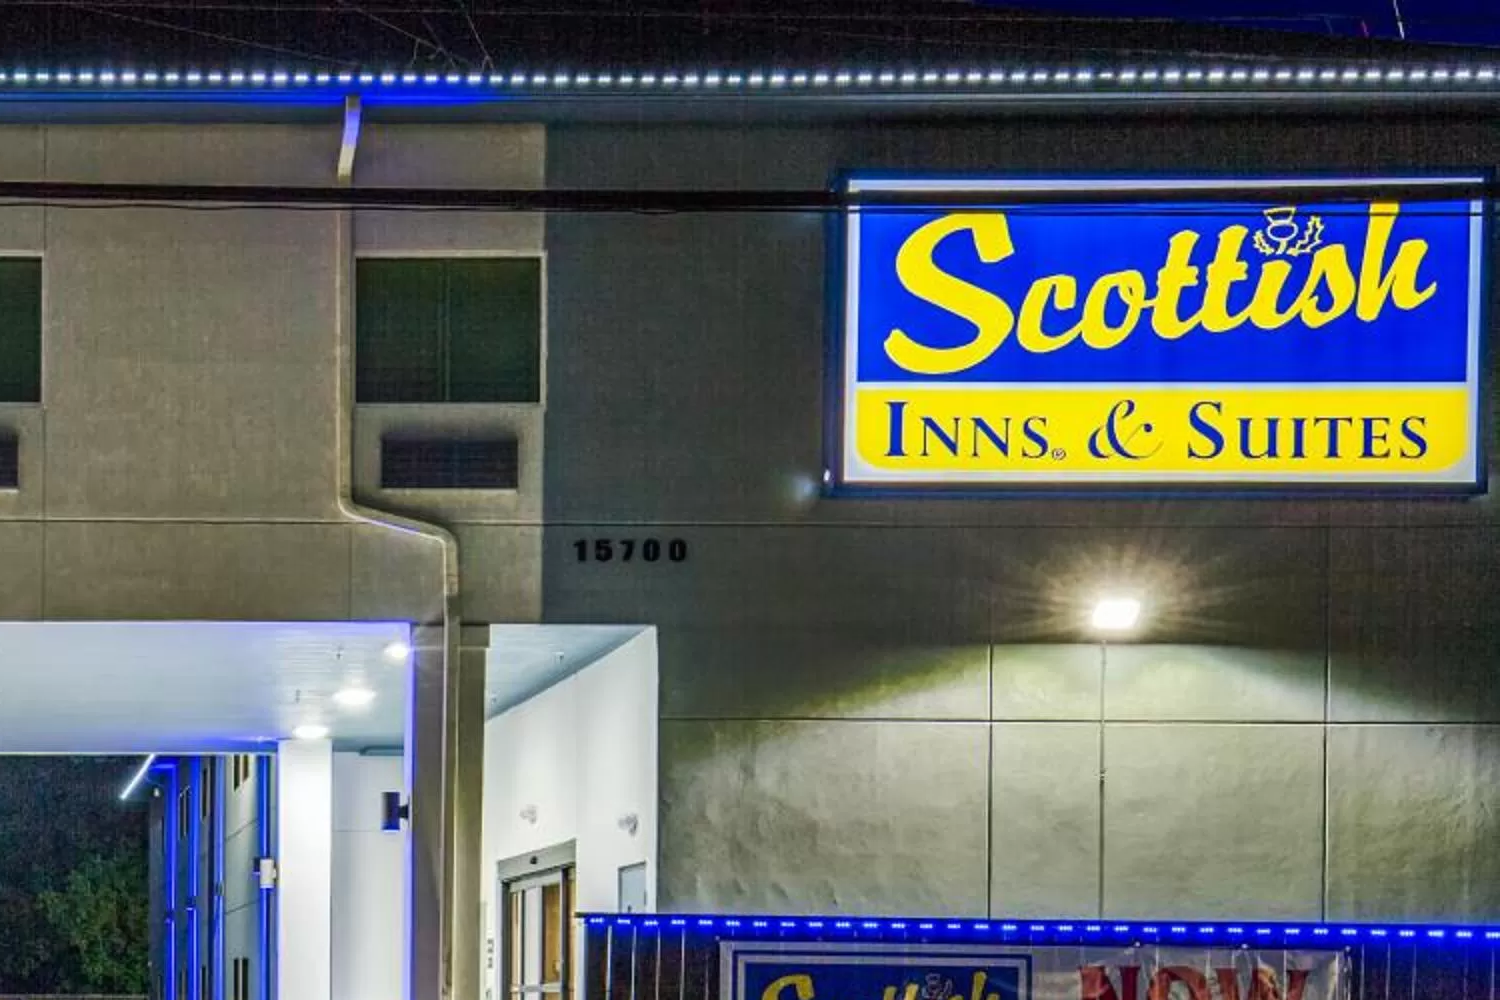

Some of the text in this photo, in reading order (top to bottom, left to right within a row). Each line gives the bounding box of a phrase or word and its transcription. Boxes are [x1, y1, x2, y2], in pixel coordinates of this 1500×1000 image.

[884, 199, 1437, 374] Scottish
[1088, 398, 1165, 460] &
[1186, 399, 1428, 459] SUITES
[573, 538, 687, 562] 15700
